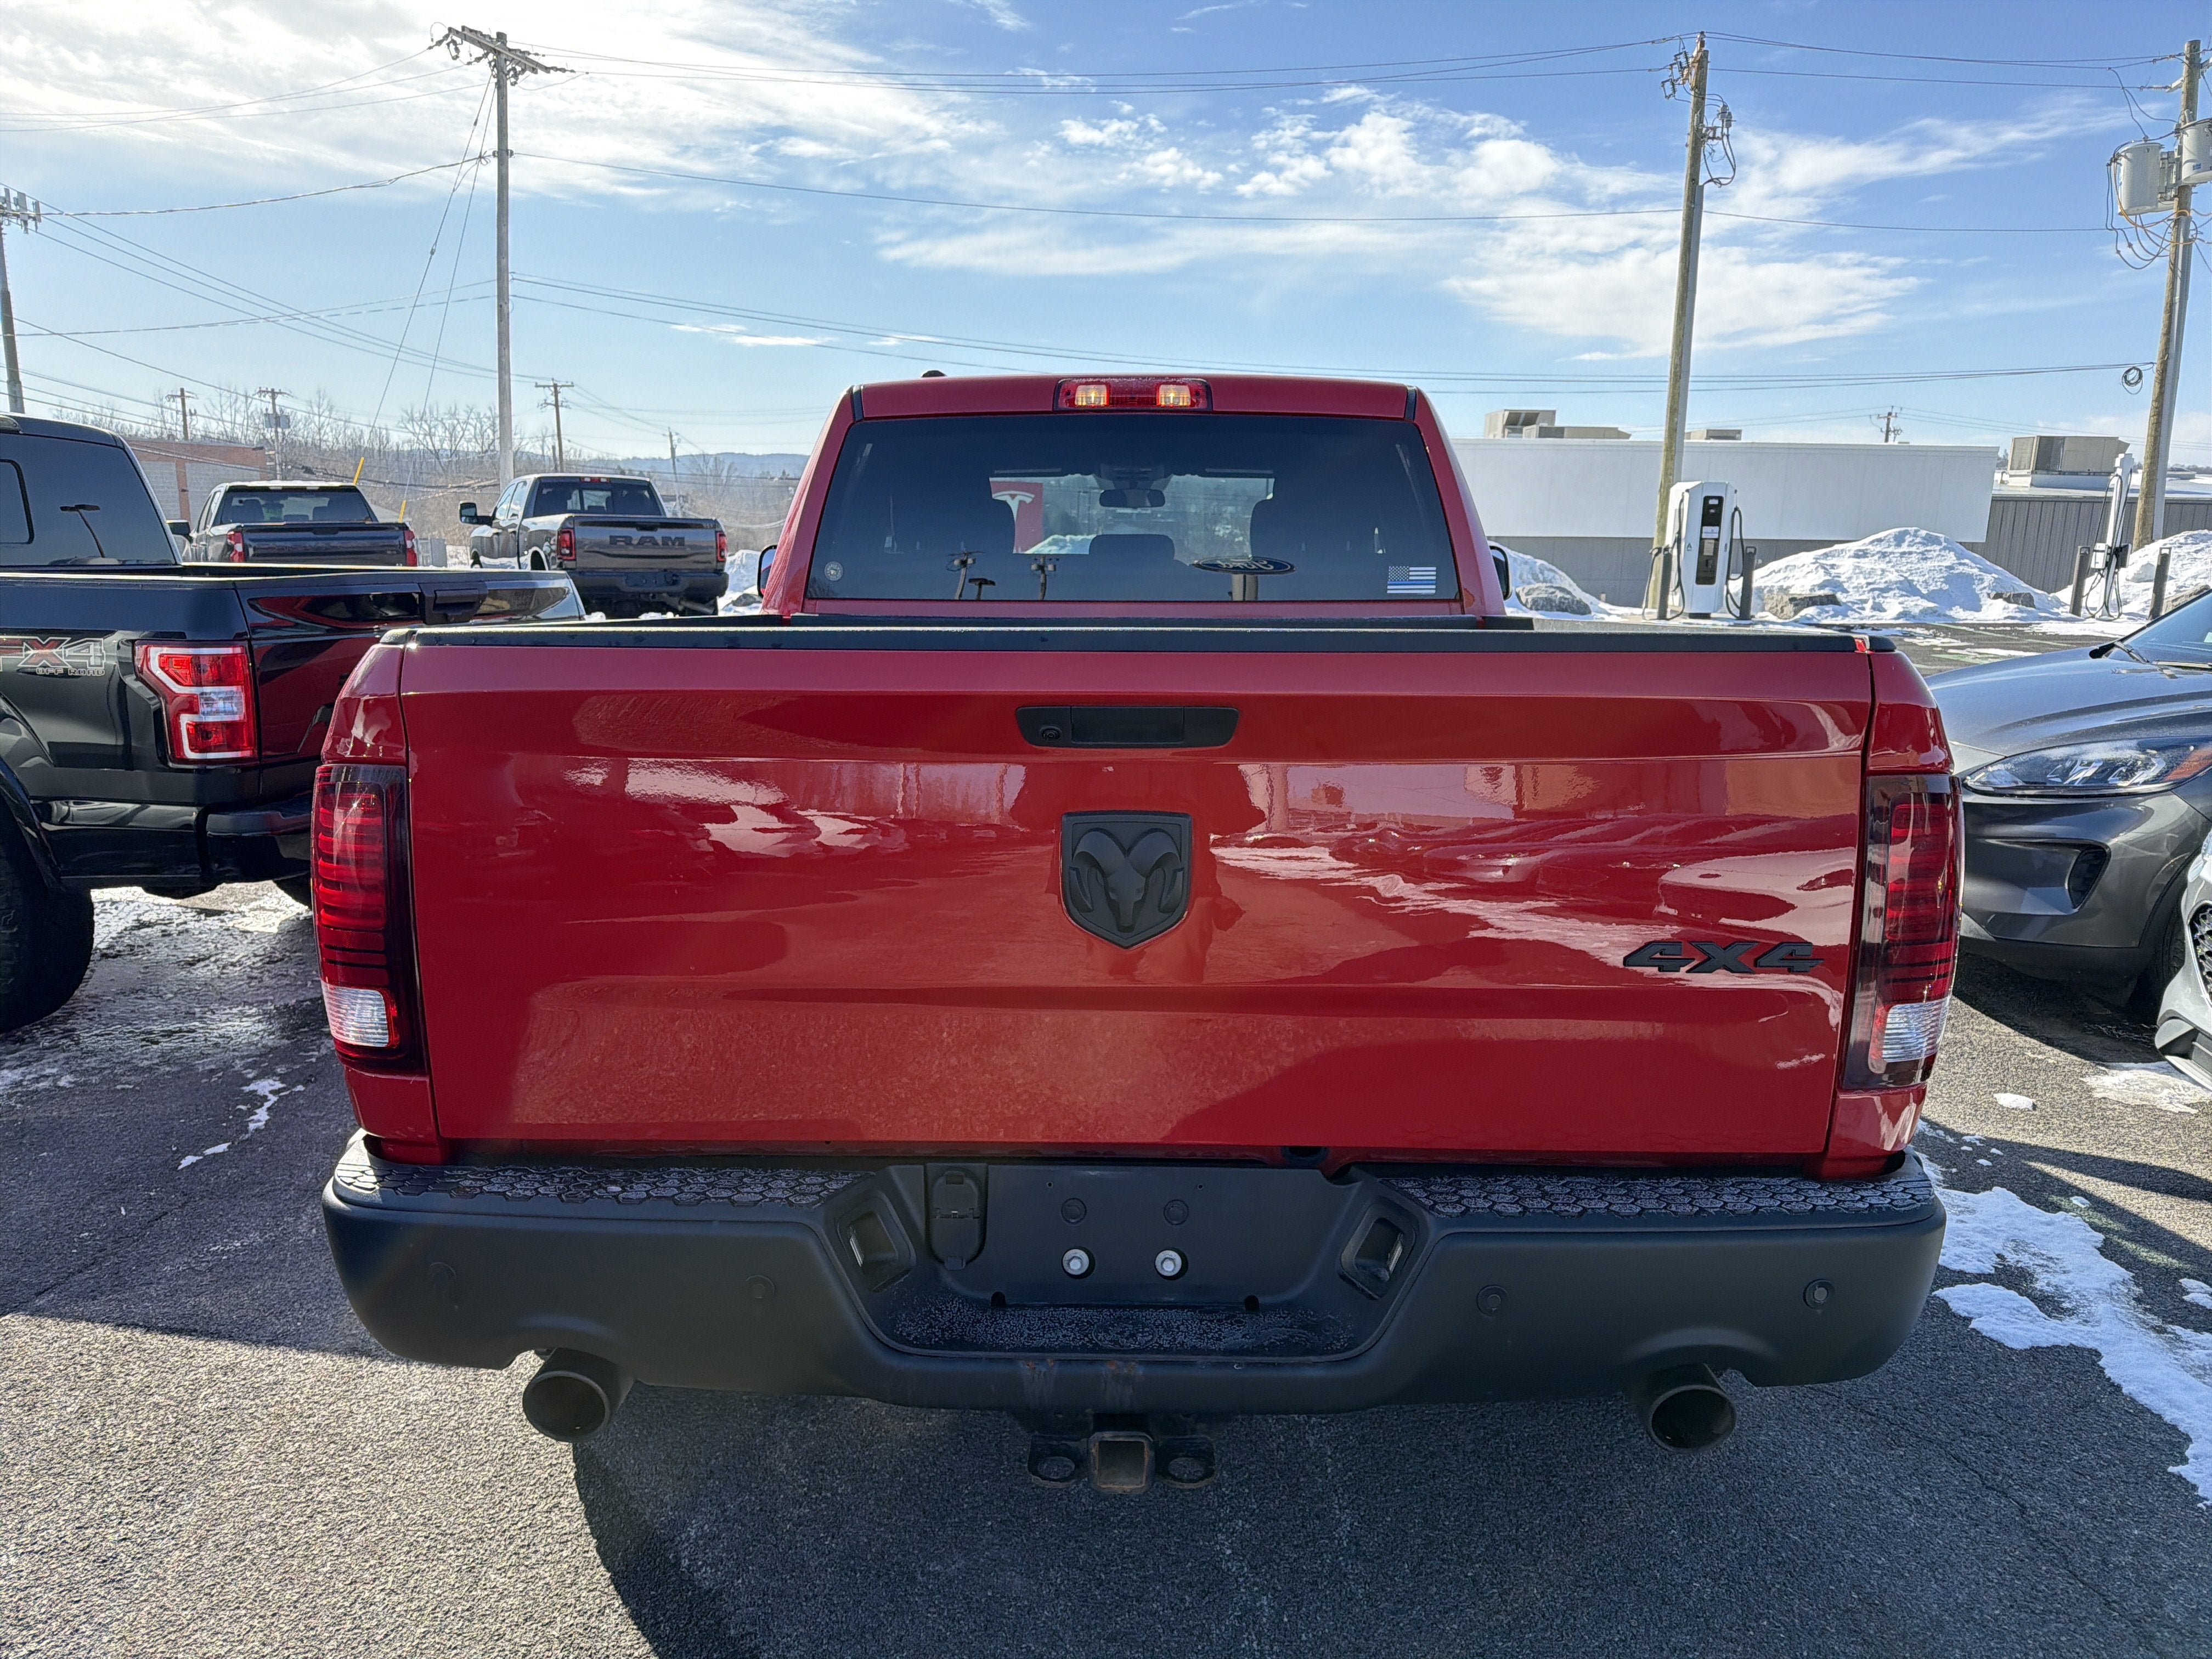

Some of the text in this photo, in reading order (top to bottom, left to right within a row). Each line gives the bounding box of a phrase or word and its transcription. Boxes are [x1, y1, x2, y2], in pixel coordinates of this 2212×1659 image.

[610, 535, 686, 546] RAM
[36, 667, 105, 676] OFF ROAD
[1622, 941, 1825, 974] 4X4
